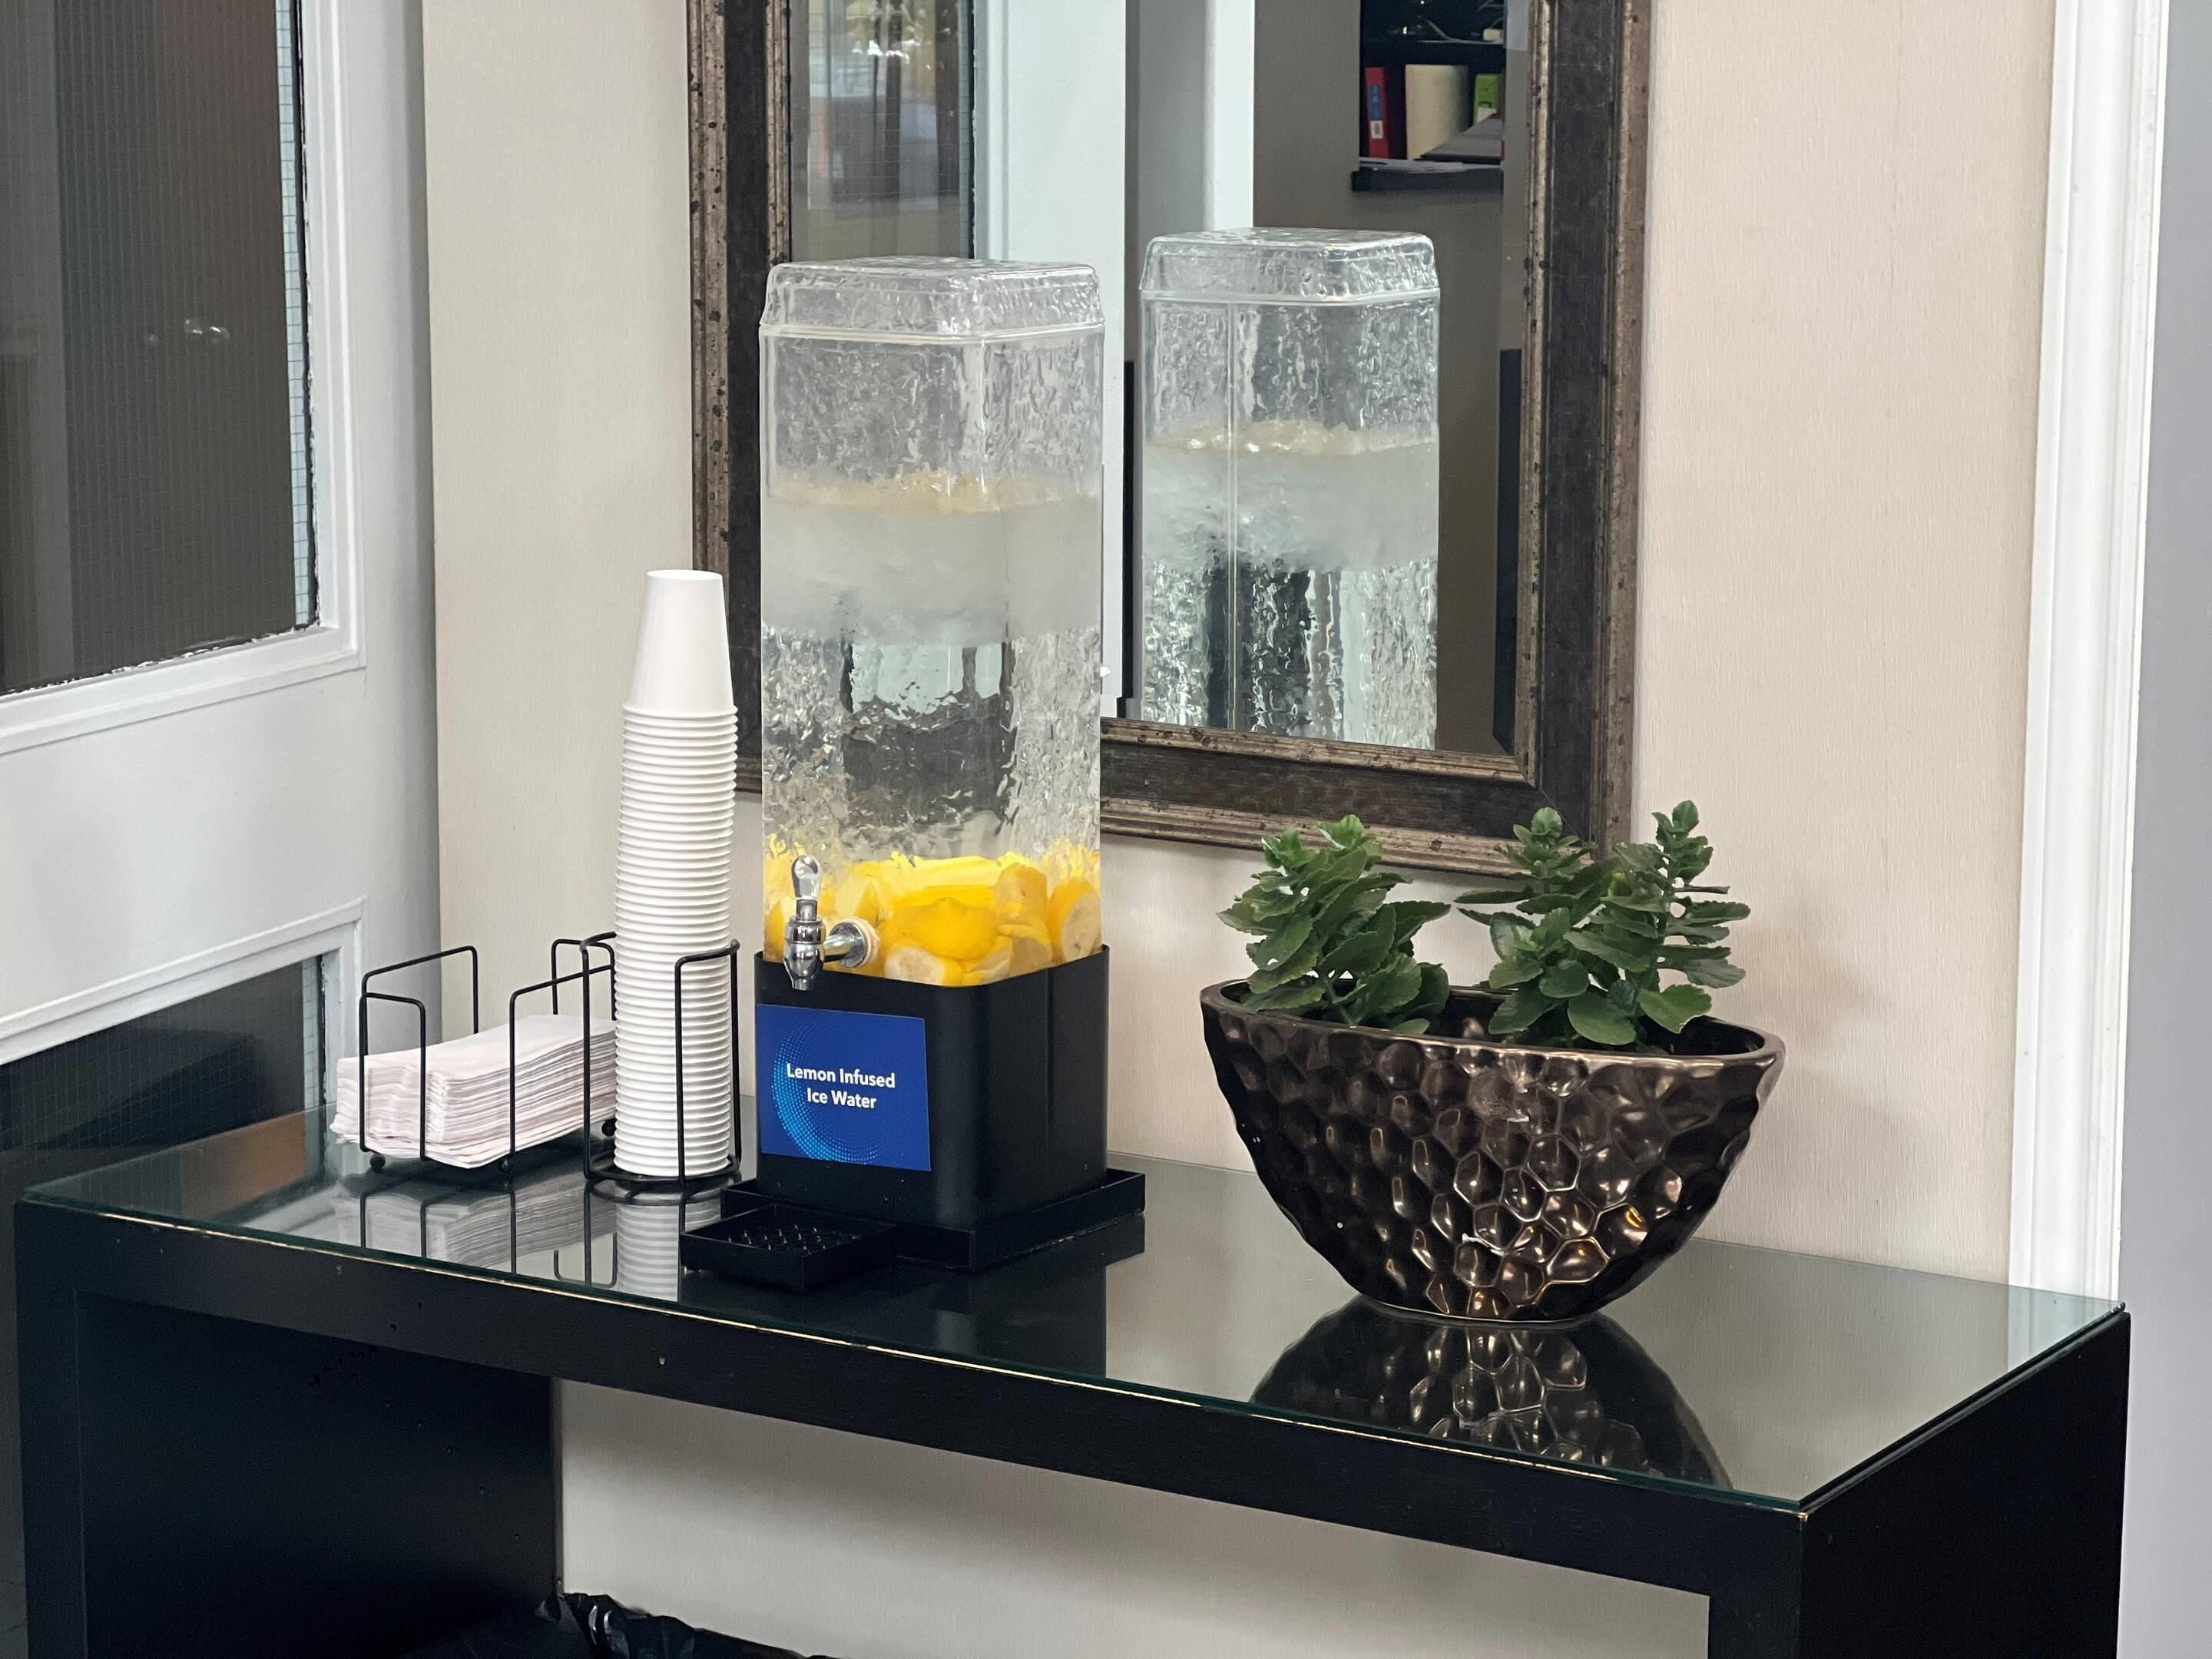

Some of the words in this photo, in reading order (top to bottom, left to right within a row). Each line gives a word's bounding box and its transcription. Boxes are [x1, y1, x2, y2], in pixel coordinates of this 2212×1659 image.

[786, 1063, 836, 1082] Lemon
[839, 1068, 896, 1088] Infused
[807, 1088, 828, 1104] Ice
[831, 1091, 877, 1109] Water
